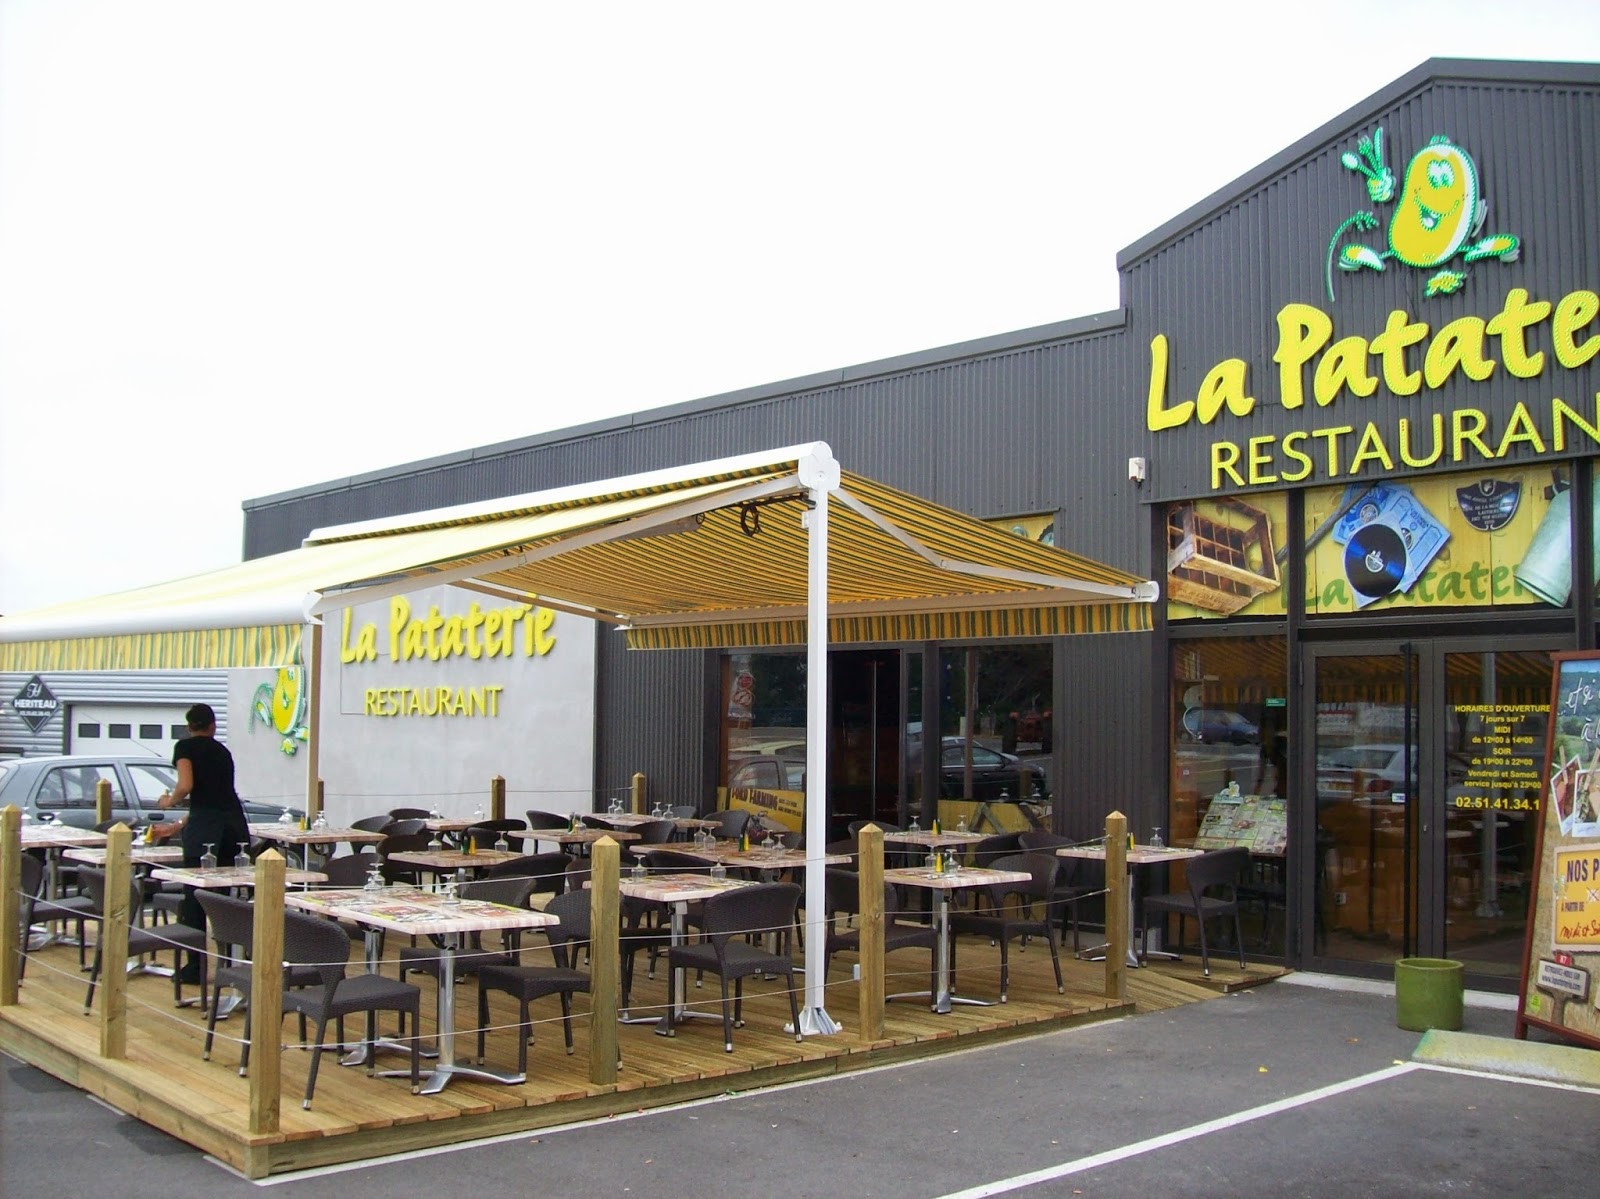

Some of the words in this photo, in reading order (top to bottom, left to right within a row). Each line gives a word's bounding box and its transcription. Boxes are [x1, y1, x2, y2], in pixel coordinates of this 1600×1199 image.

[1147, 334, 1255, 432] La
[1273, 288, 1600, 409] Patate
[340, 605, 376, 663] La
[389, 592, 556, 662] Pataterie
[14, 699, 57, 709] HERITEAU
[364, 686, 502, 717] RESTAURANT
[1454, 705, 1494, 713] HORAIRES
[1495, 705, 1550, 713] D'OUVERTURE
[1485, 716, 1505, 724] jours
[1471, 736, 1481, 744] de
[1510, 771, 1538, 779] Samedi
[1566, 859, 1589, 883] NOS
